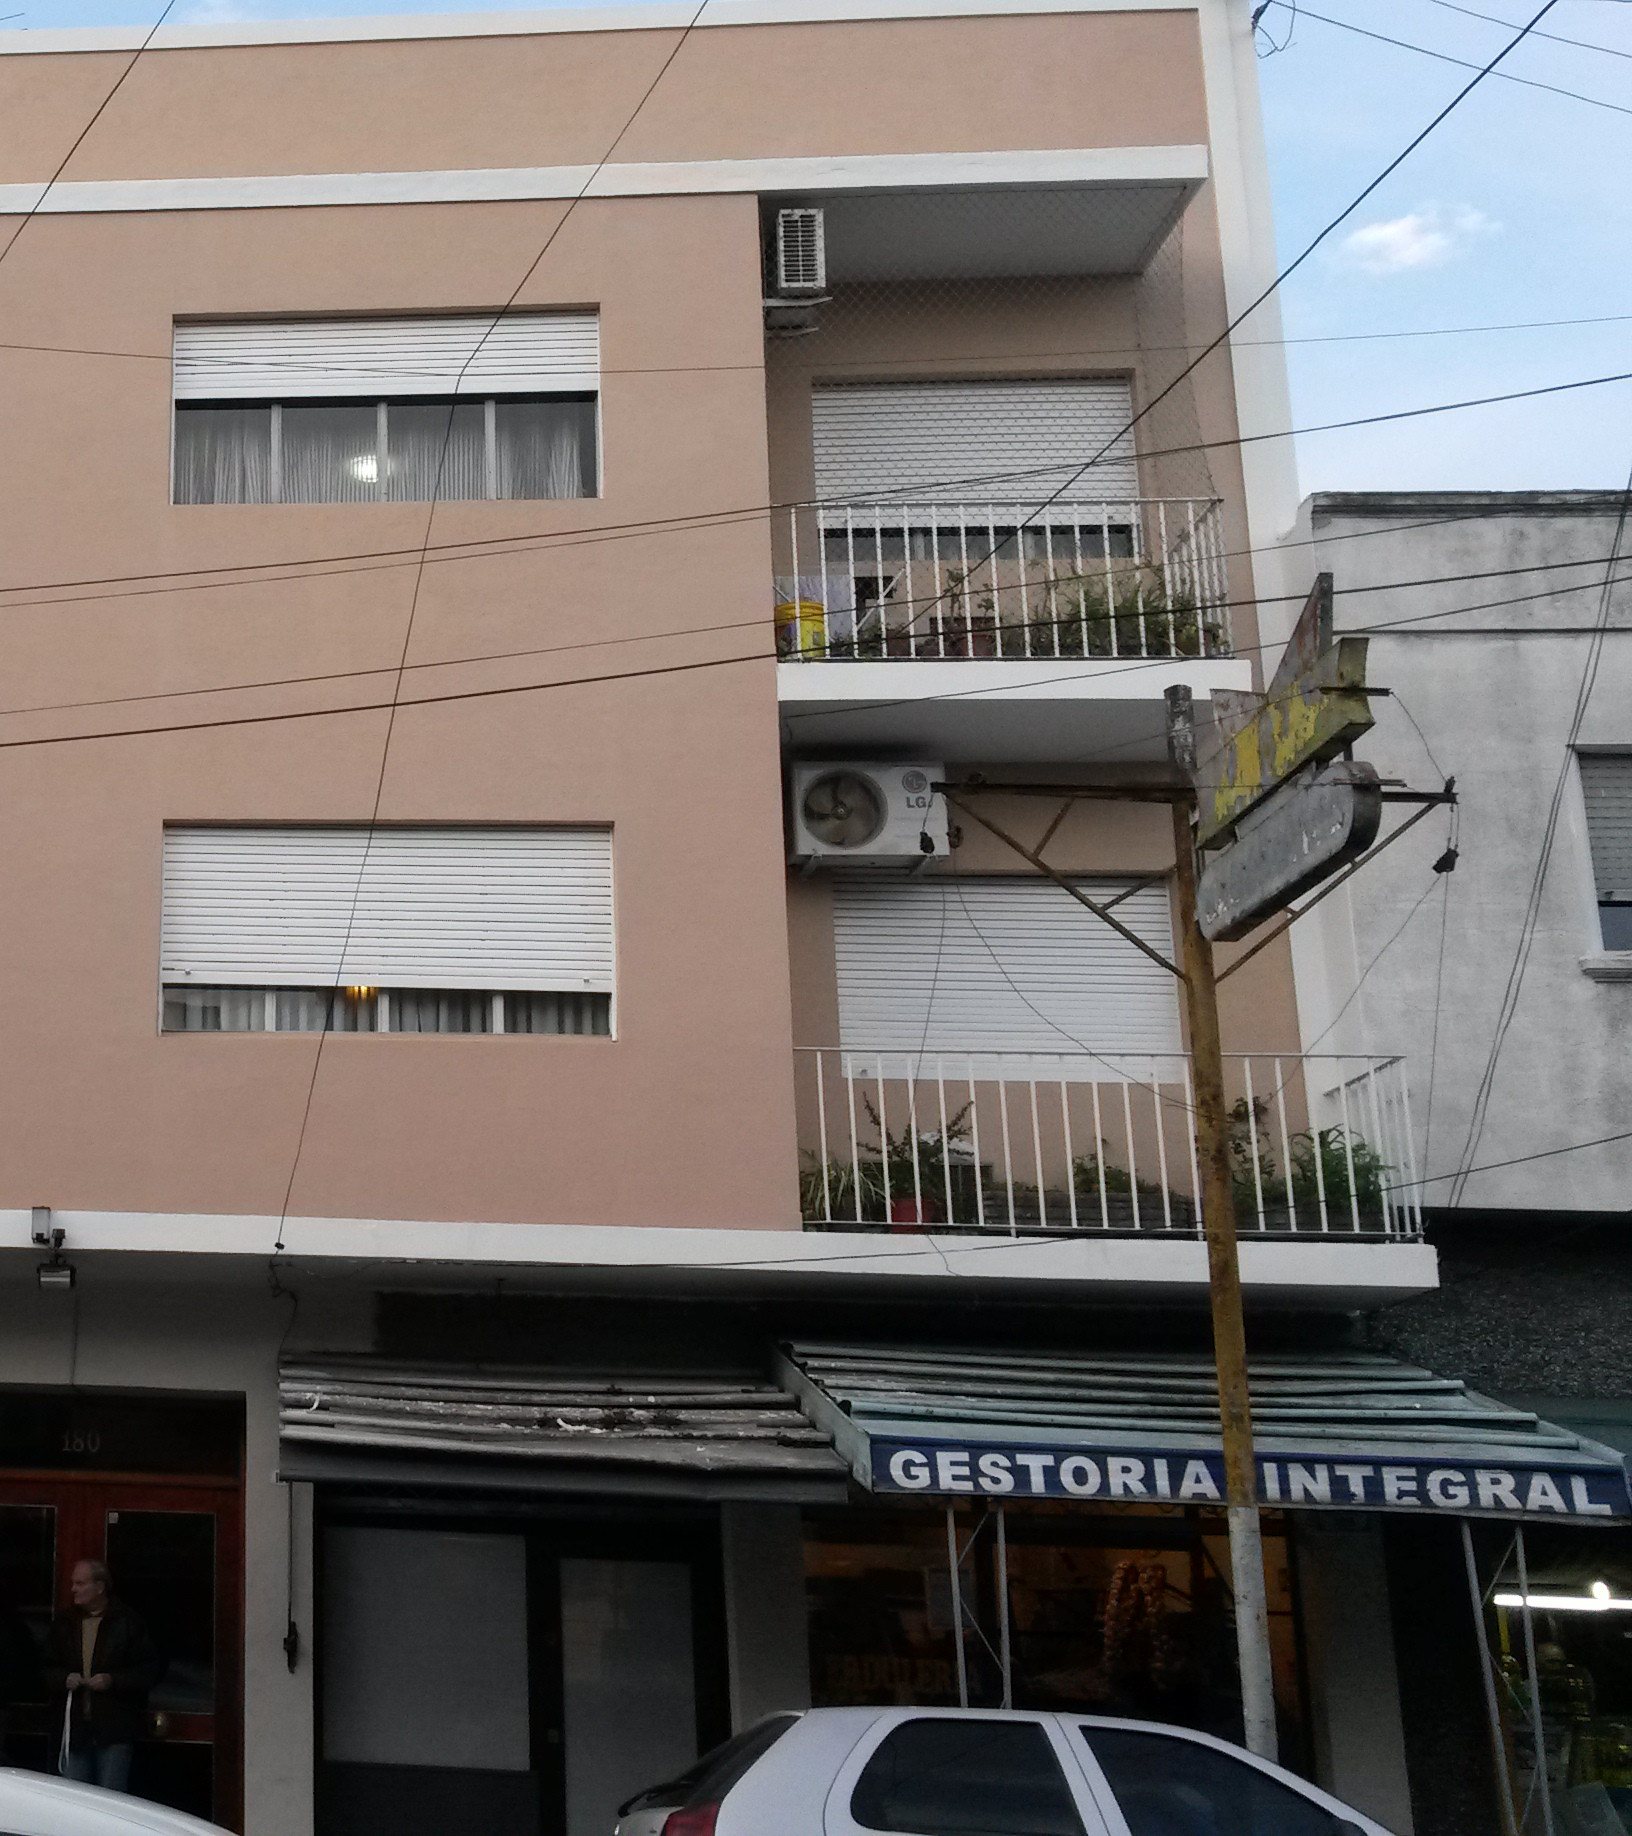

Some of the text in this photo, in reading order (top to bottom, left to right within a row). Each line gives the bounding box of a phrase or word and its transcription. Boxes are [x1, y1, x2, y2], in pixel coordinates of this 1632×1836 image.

[60, 1429, 100, 1453] 180
[889, 1448, 1614, 1516] GESTORIA INTEGRAL
